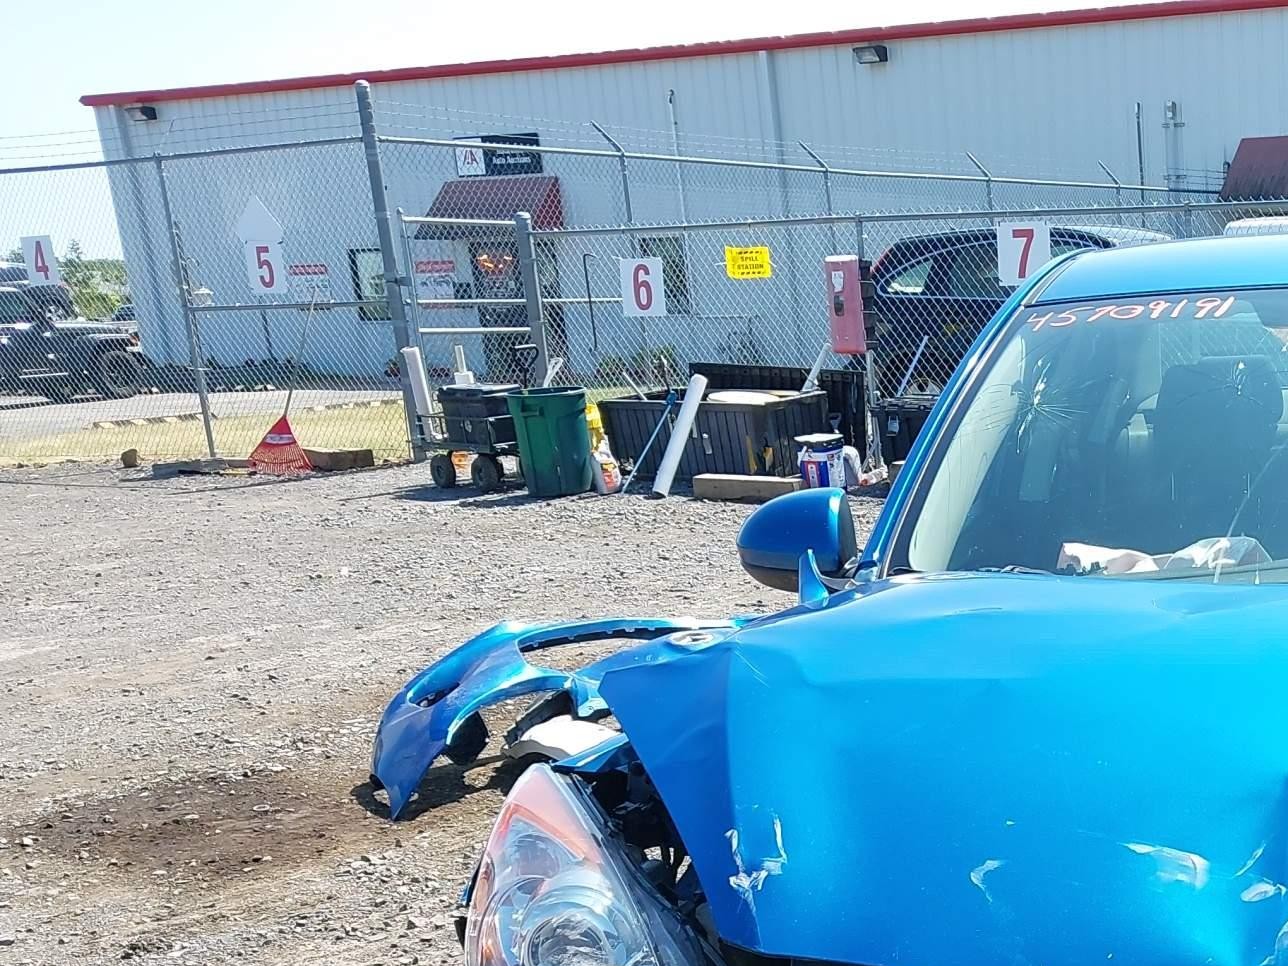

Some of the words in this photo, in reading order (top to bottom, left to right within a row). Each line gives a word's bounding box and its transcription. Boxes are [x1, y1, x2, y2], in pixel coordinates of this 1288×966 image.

[35, 240, 49, 280] 4
[255, 246, 275, 288] 5
[1012, 229, 1034, 279] 7
[633, 263, 652, 311] 6
[1026, 296, 1234, 331] 45709191
